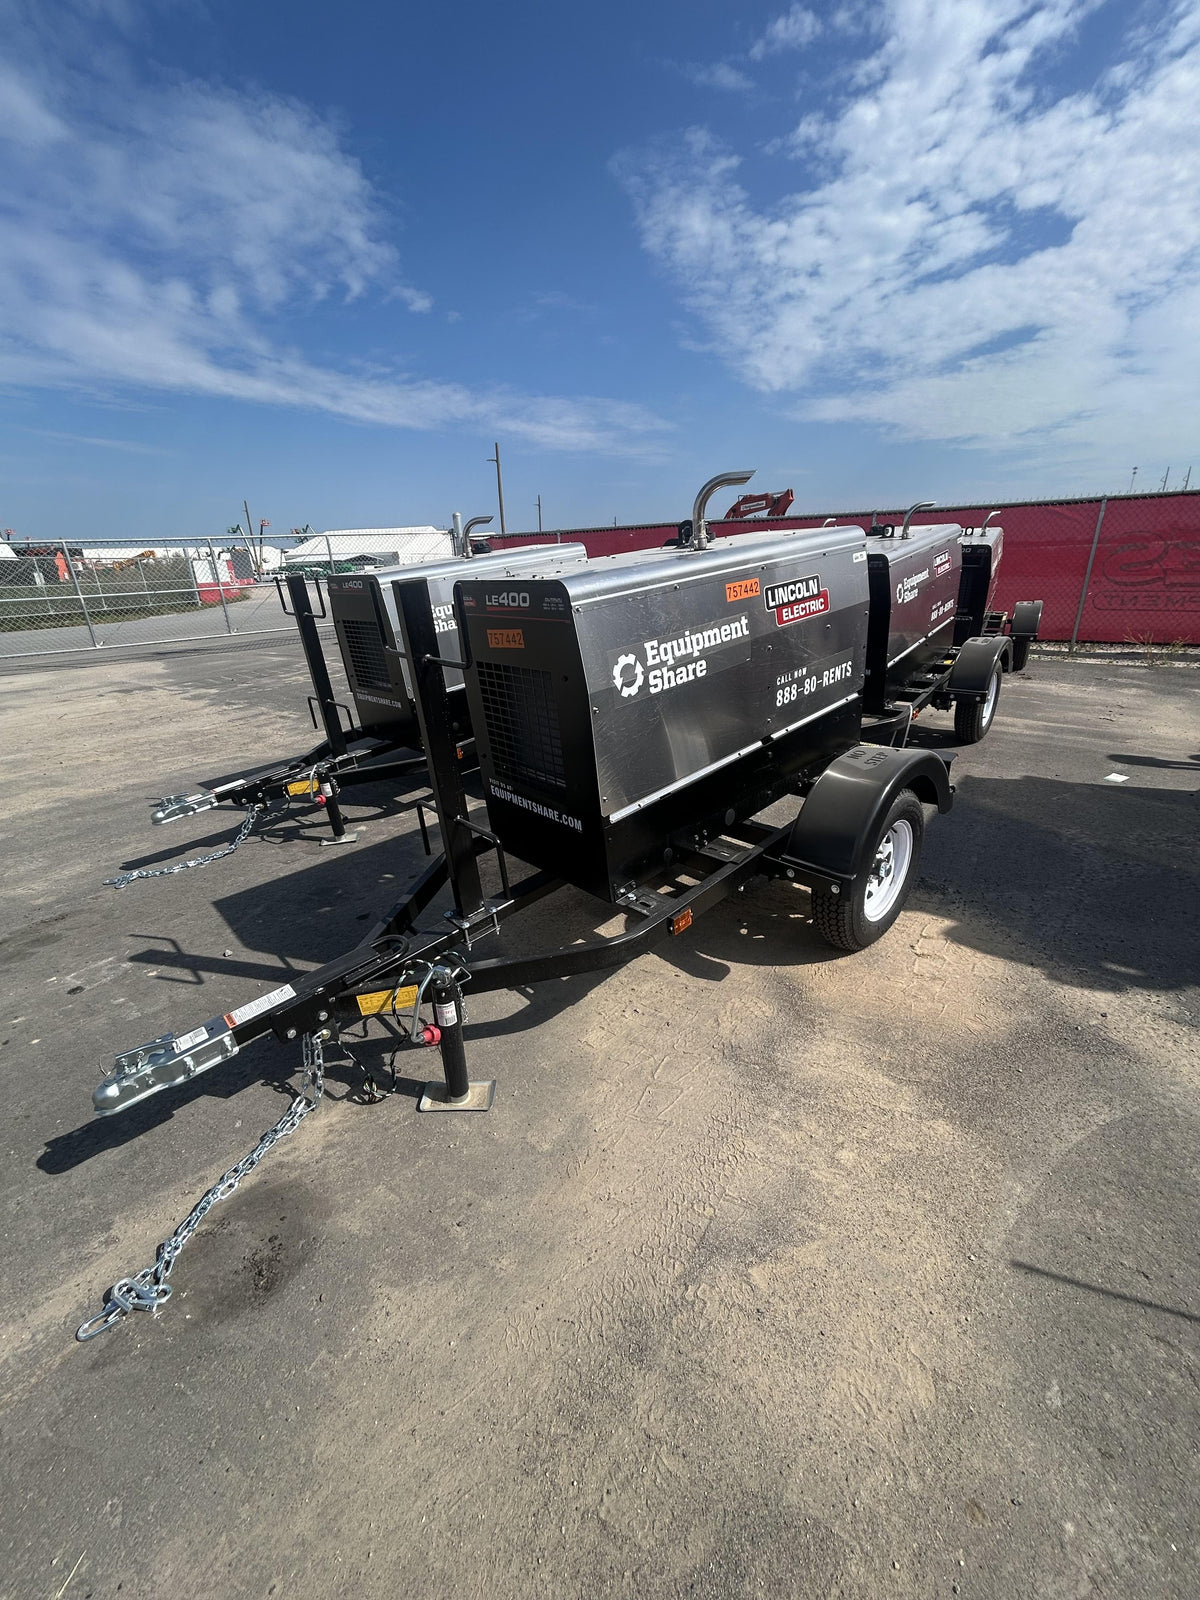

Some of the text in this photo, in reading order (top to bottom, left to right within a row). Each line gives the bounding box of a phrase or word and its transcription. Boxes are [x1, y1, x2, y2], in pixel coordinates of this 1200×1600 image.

[485, 592, 530, 607] LE400
[726, 581, 760, 599] 757442
[767, 578, 819, 607] LINCOLN
[782, 597, 825, 621] ELECTRIC
[488, 632, 524, 646] 757442
[643, 615, 750, 667] Equipment
[648, 659, 707, 695] Share
[775, 660, 853, 707] 888-80-RENTS
[776, 667, 807, 686] CALL NOW
[490, 784, 583, 831] EQUIPMENTSHARE.COM
